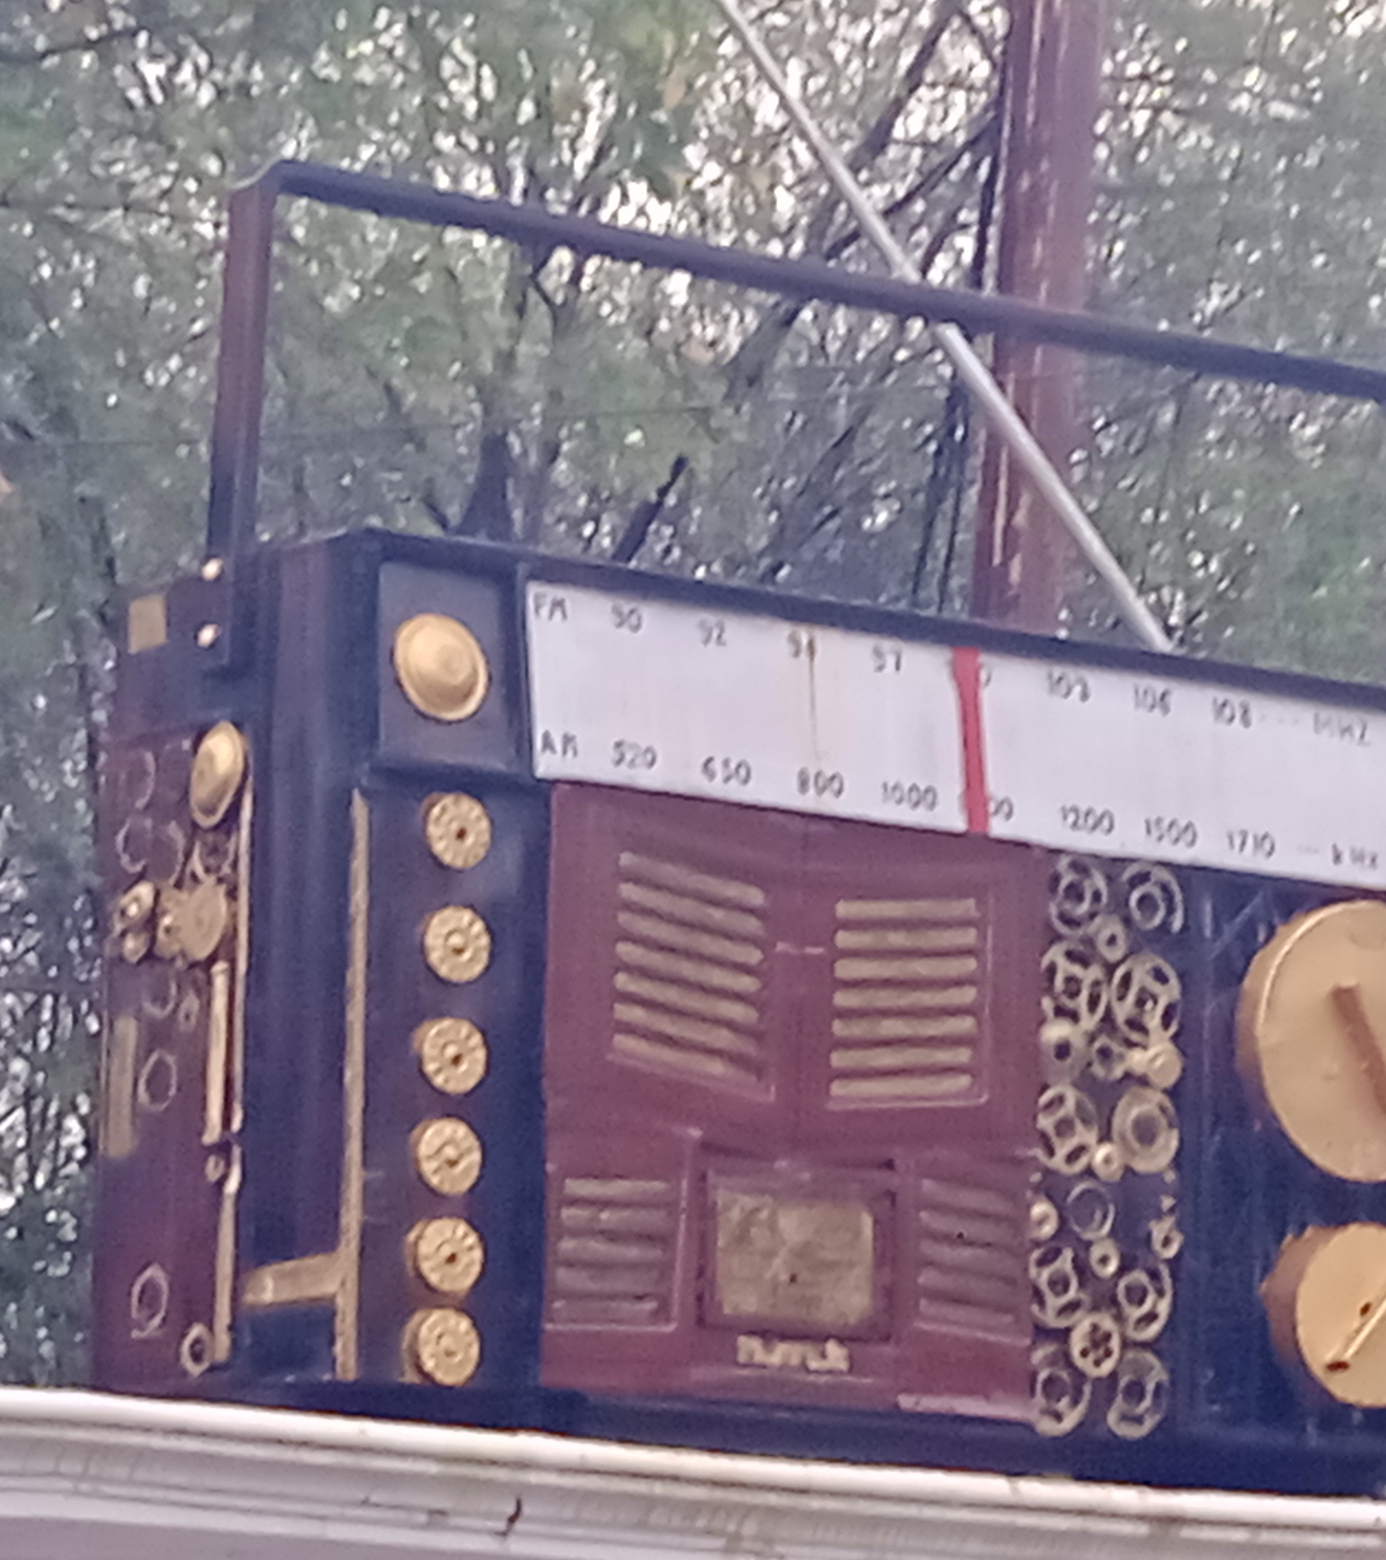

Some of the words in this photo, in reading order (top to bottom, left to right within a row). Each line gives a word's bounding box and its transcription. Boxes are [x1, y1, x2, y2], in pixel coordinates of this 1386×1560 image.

[533, 592, 568, 621] FM
[541, 730, 579, 758] AM
[797, 767, 844, 799] 800
[881, 781, 937, 812] 1000
[1060, 804, 1115, 836] 1200
[1145, 816, 1198, 848] 1500
[1227, 829, 1276, 859] 1710
